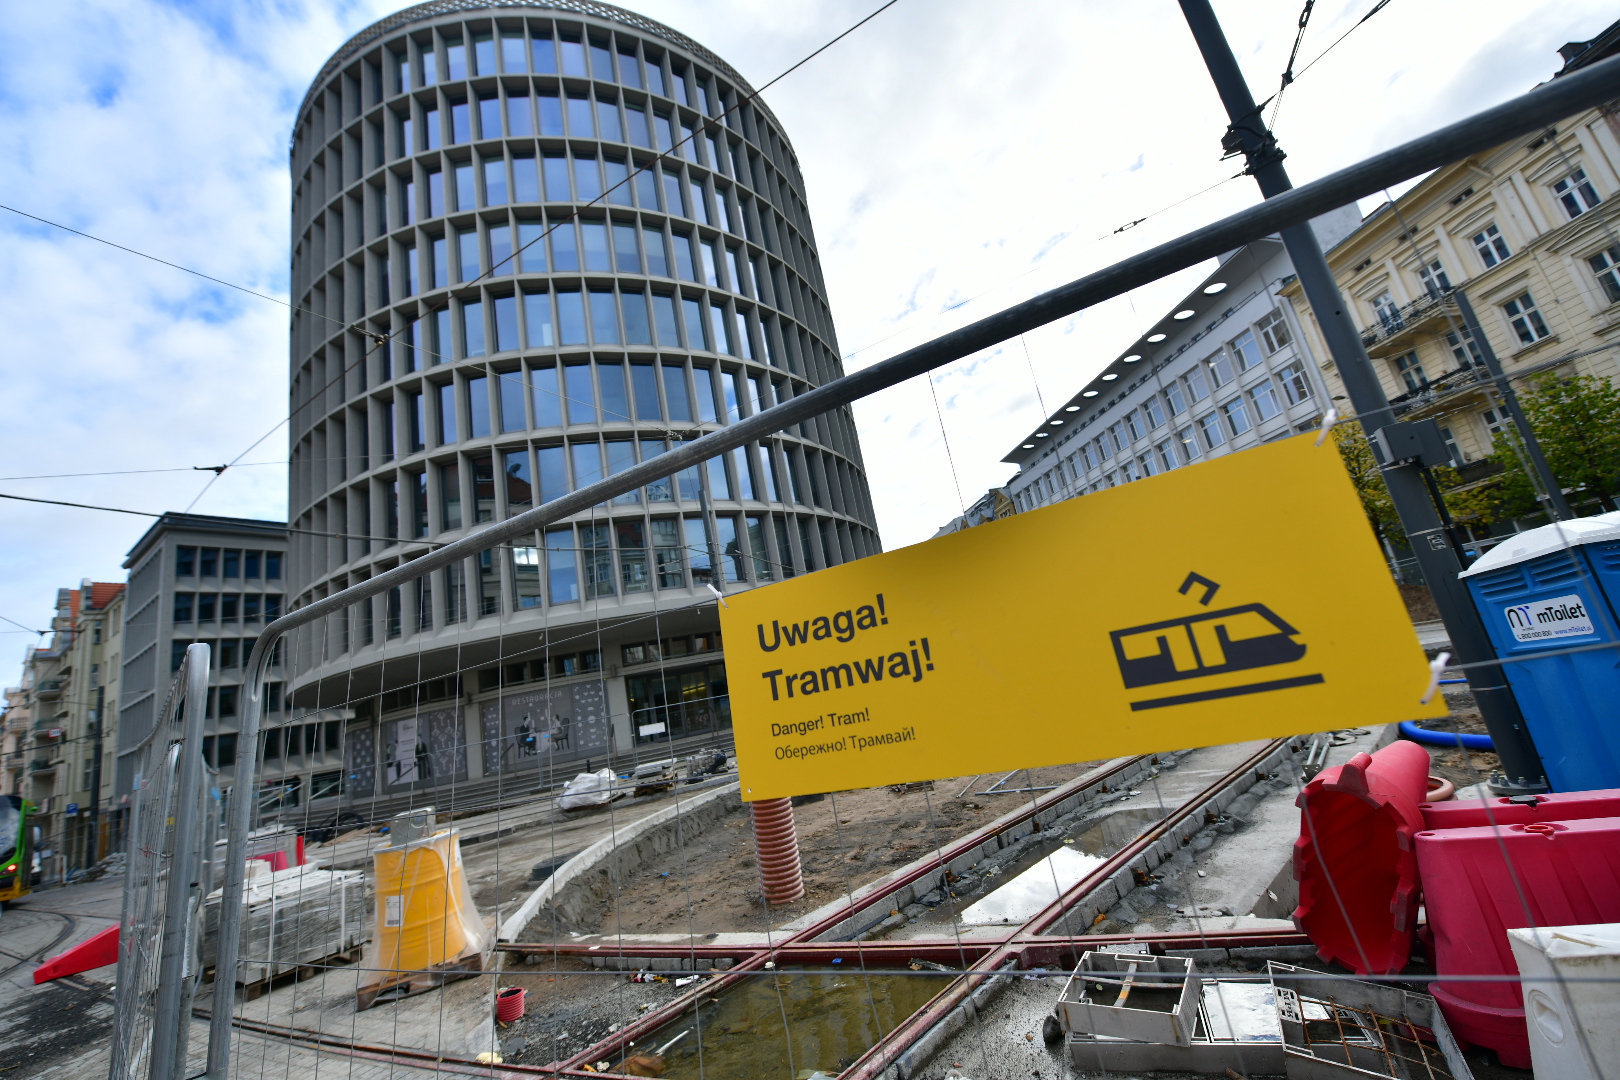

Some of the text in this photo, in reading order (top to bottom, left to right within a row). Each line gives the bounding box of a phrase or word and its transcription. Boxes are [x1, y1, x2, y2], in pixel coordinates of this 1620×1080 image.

[757, 593, 889, 652] Uwaga!
[1536, 603, 1586, 624] mToilet
[762, 637, 935, 702] Tramwaj!
[771, 707, 870, 737] Danger! Tram!
[775, 726, 916, 760] Обережно! Трамвай!
